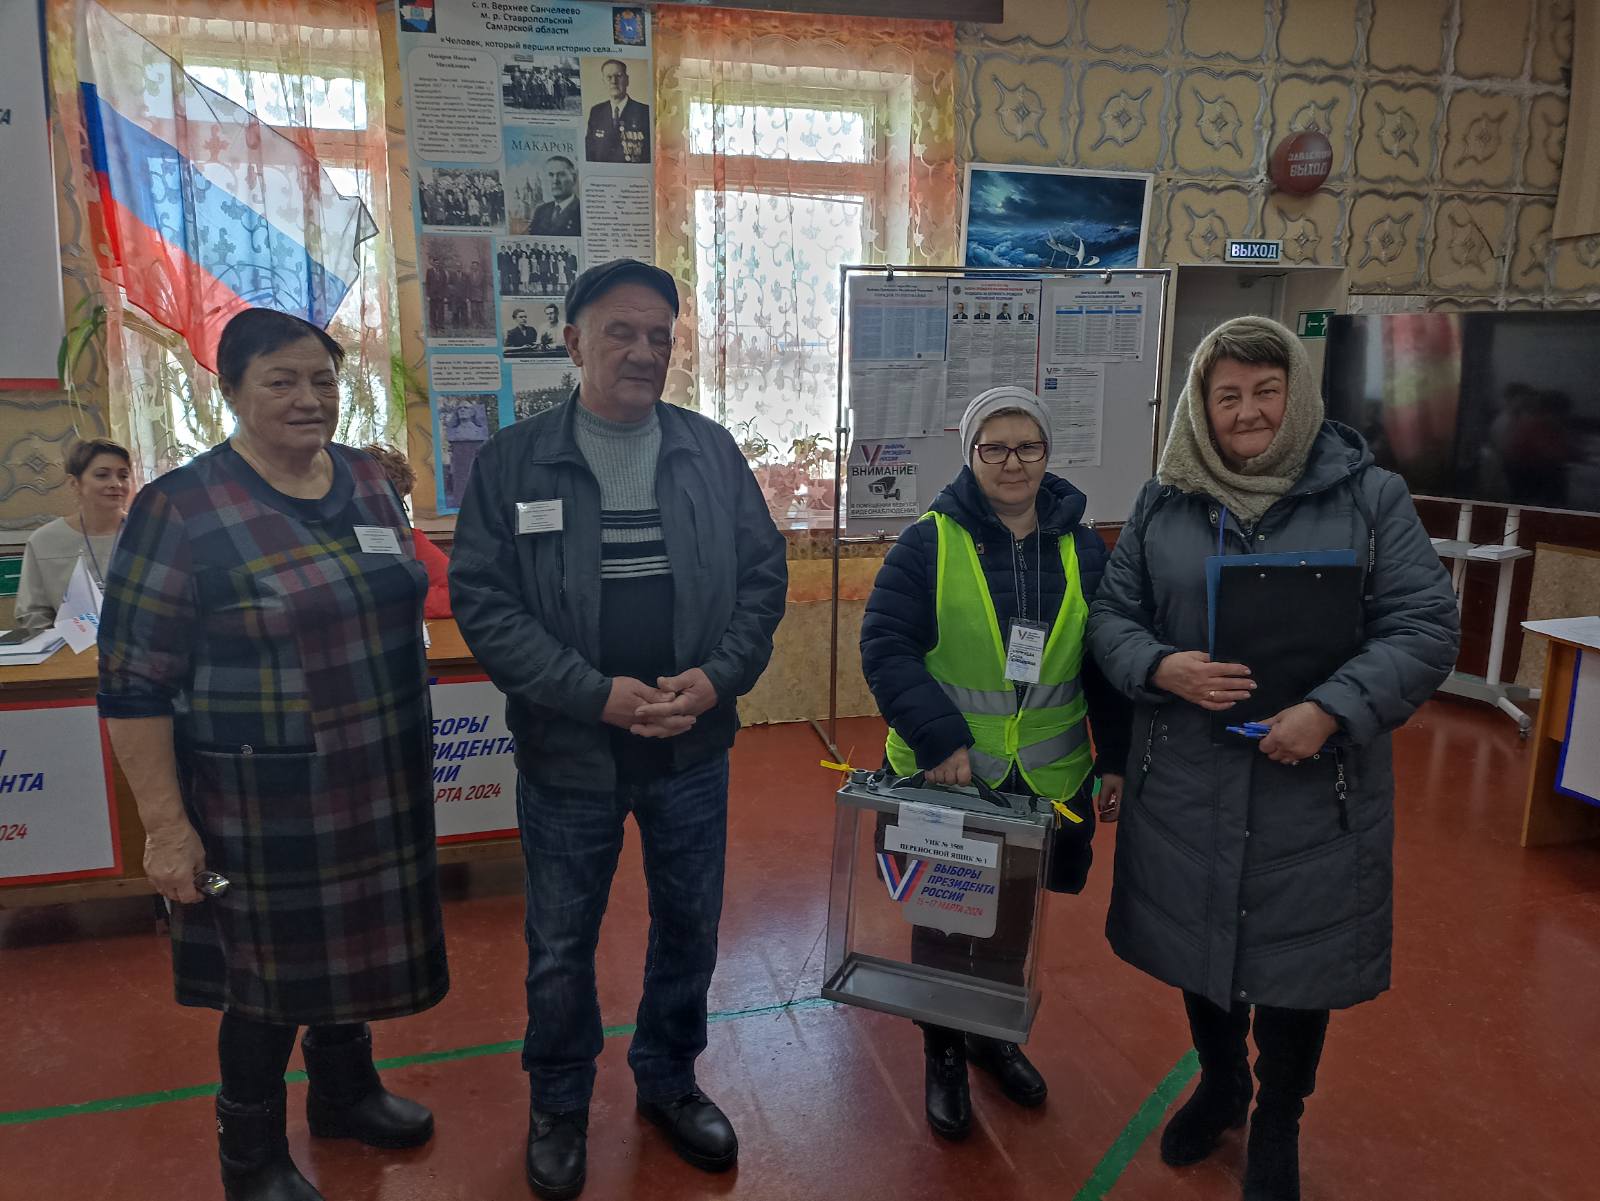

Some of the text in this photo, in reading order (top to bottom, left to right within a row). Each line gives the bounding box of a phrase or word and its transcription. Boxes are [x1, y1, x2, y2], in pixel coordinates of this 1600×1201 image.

[491, 1, 528, 13] Верхнее
[530, 4, 581, 15] Санчелеево
[503, 12, 573, 25] Ставропольский
[485, 21, 569, 35] Самарской области
[485, 40, 521, 51] который
[522, 43, 555, 52] вершил
[556, 45, 591, 54] историю
[1290, 162, 1329, 177] ВЫХОД
[1231, 243, 1278, 259] ВЫХОД
[852, 465, 917, 477] ВНИМАНИЕ!
[433, 783, 501, 803] РТА 2024
[899, 843, 949, 858] ПЕРЕНОСНОЙ
[950, 851, 974, 862] ЯЩИК
[933, 863, 982, 880] ВЫБОРЫ
[927, 875, 996, 895] ПРЕЗИДЕНТА
[920, 886, 965, 902] РОССИИ
